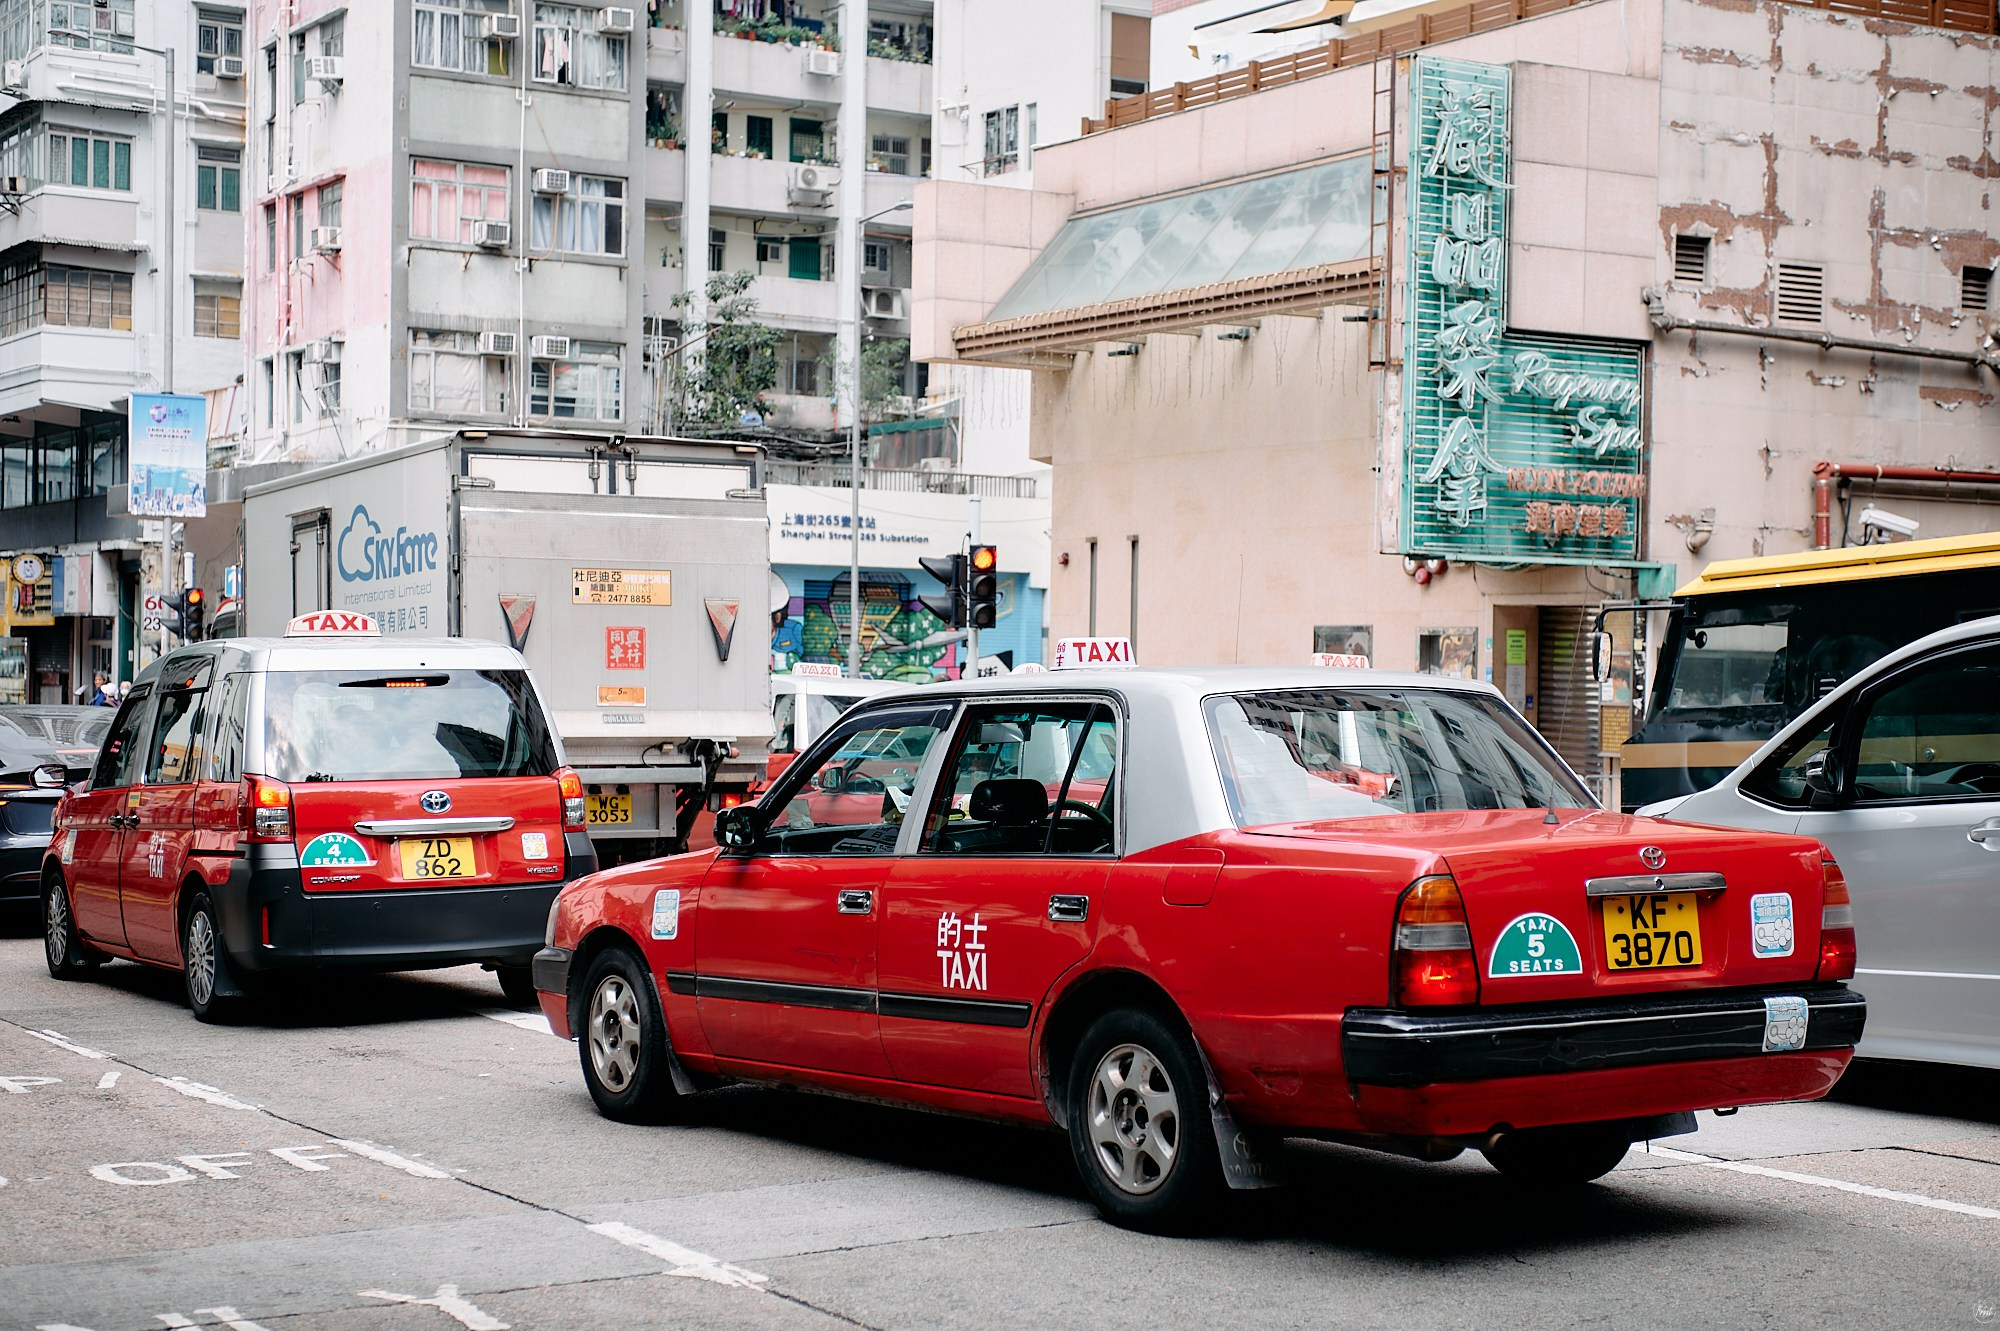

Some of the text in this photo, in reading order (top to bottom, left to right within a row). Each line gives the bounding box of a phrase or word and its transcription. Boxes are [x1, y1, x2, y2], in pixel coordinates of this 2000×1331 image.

[1510, 351, 1641, 417] Regency
[1571, 406, 1644, 460] Spa
[781, 530, 929, 544] Shanghai Stree 265 Substation
[574, 570, 622, 583] 杜尼迪亞
[344, 581, 432, 605] International Limited
[608, 594, 652, 603] 2477 8855
[302, 614, 369, 632] TAXI
[1056, 642, 1066, 667] 的士
[1072, 641, 1130, 663] TAXI
[1321, 654, 1366, 668] TAXI
[800, 664, 838, 676] TAXI
[598, 796, 619, 809] WG
[588, 809, 629, 823] 3053
[319, 836, 348, 846] TAXI
[326, 844, 342, 857] 4
[422, 839, 452, 859] ZD
[148, 854, 164, 878] TAXI
[313, 857, 356, 866] SEATS
[415, 858, 463, 878] 862
[1630, 895, 1669, 930] KF
[937, 911, 988, 951] 的士
[1516, 917, 1556, 934] TAXI
[1527, 934, 1546, 958] 5
[1612, 930, 1695, 968] 3870
[936, 950, 988, 991] TAXI
[1508, 958, 1565, 973] SEATS
[87, 1144, 349, 1187] OFF
